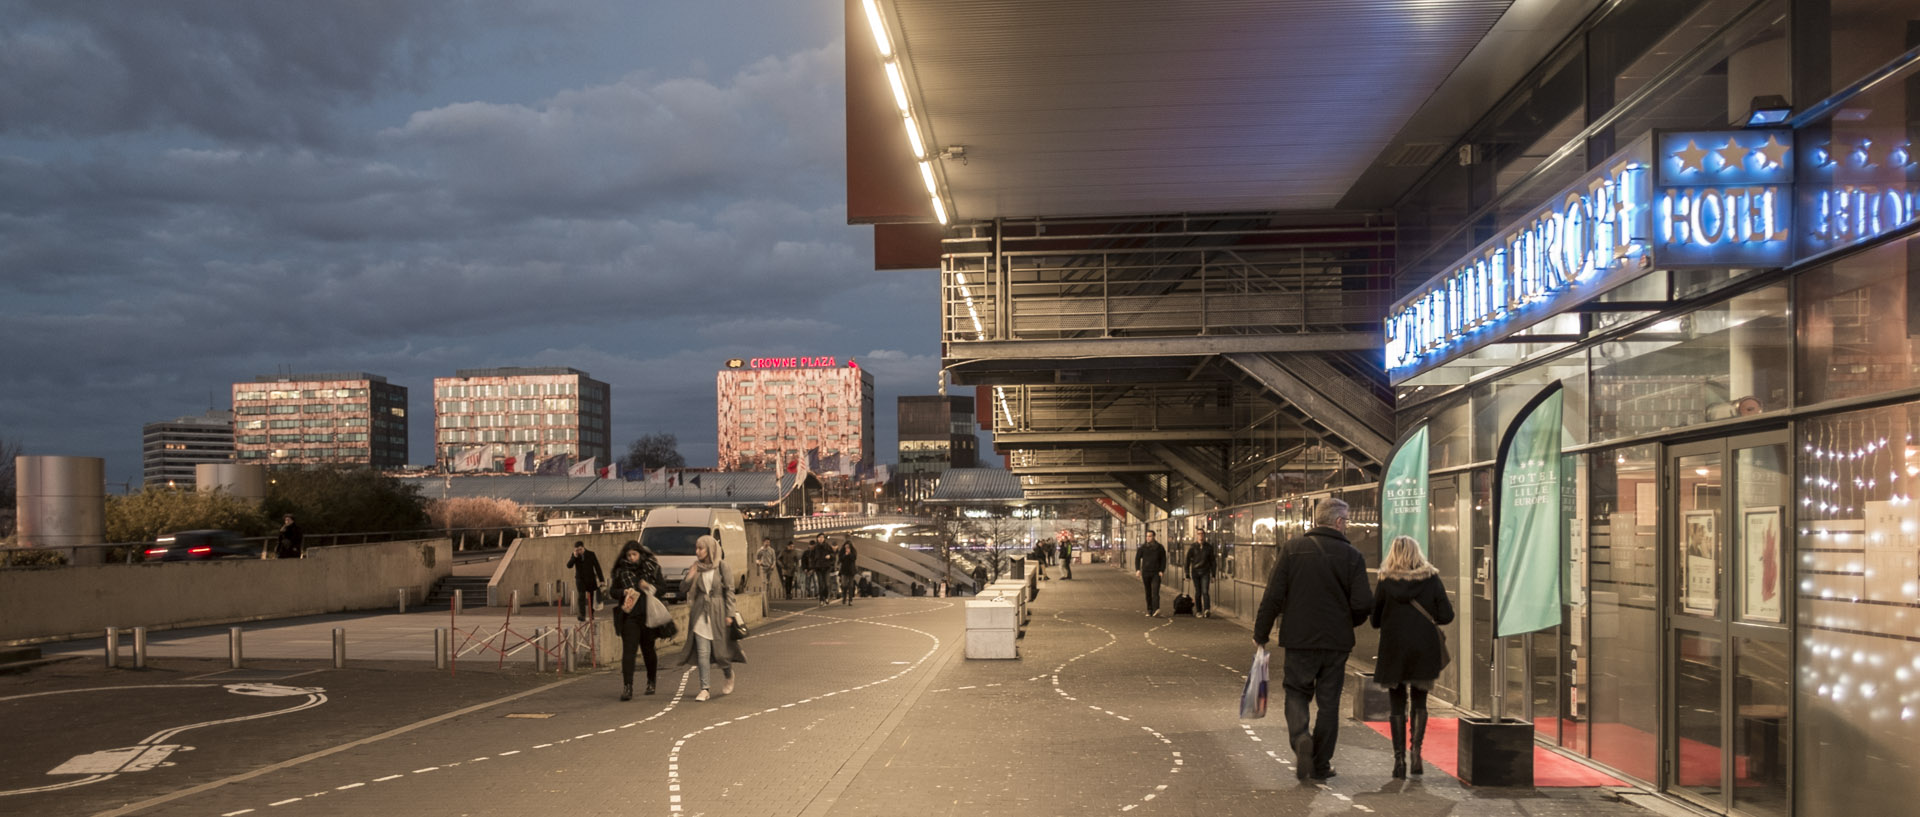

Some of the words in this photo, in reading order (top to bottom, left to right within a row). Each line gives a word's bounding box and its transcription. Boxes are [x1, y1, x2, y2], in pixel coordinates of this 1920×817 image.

[1664, 187, 1788, 246] HOTEL
[1506, 160, 1646, 311] EUROPE
[750, 358, 797, 368] CROWNE
[801, 357, 836, 367] PLAZA
[1510, 471, 1556, 485] HOTEL
[1387, 488, 1426, 498] HOTEL
[1515, 486, 1549, 497] LILLE
[1514, 496, 1549, 506] EUROPE
